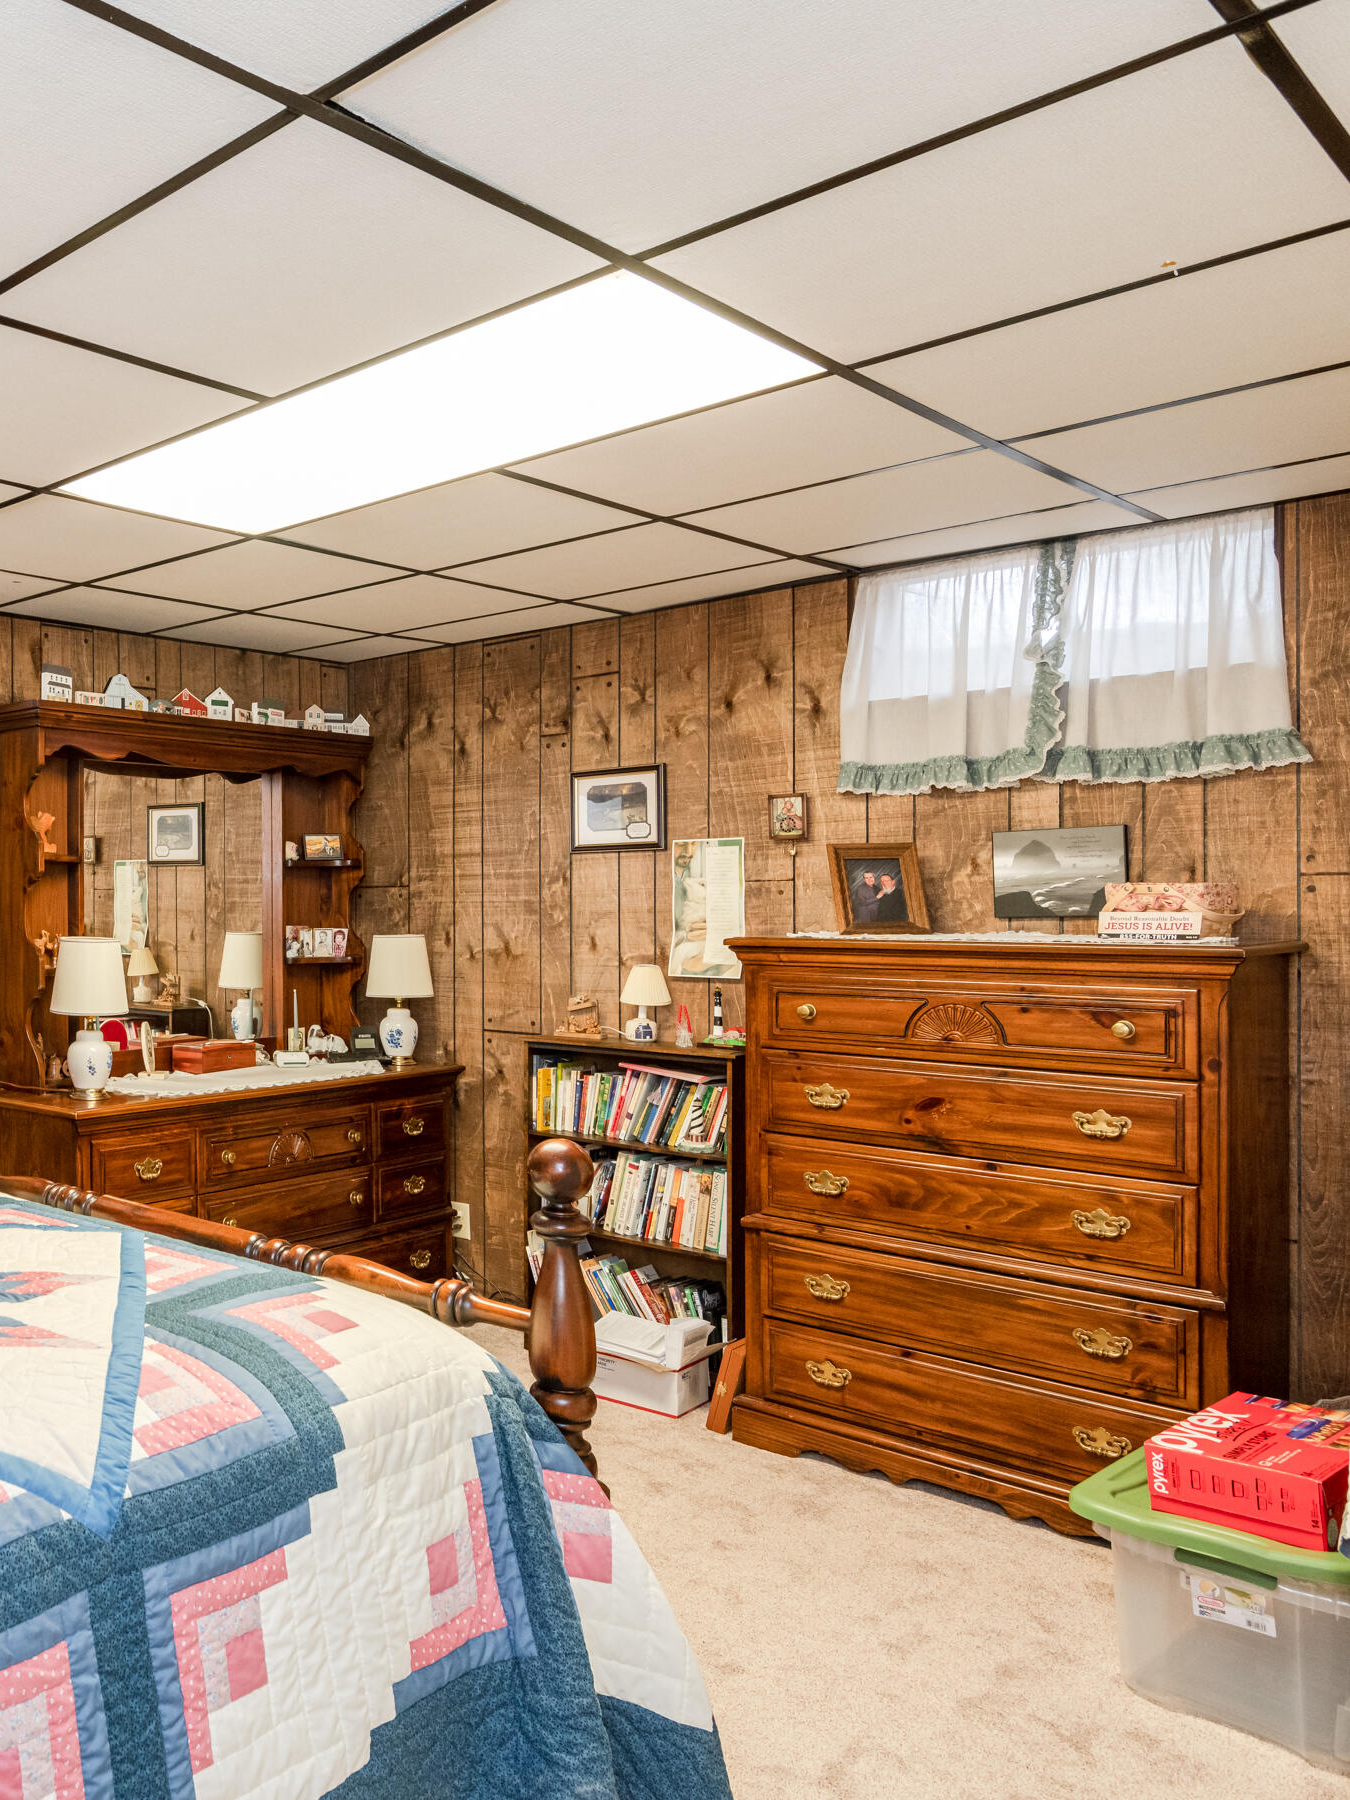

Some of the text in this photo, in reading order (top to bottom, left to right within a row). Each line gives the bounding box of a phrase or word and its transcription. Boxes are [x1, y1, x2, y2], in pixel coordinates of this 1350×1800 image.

[1104, 922, 1193, 931] JESUS IS ALIVE!
[1151, 1407, 1250, 1455] pyrex
[1151, 1451, 1169, 1494] pyrex
